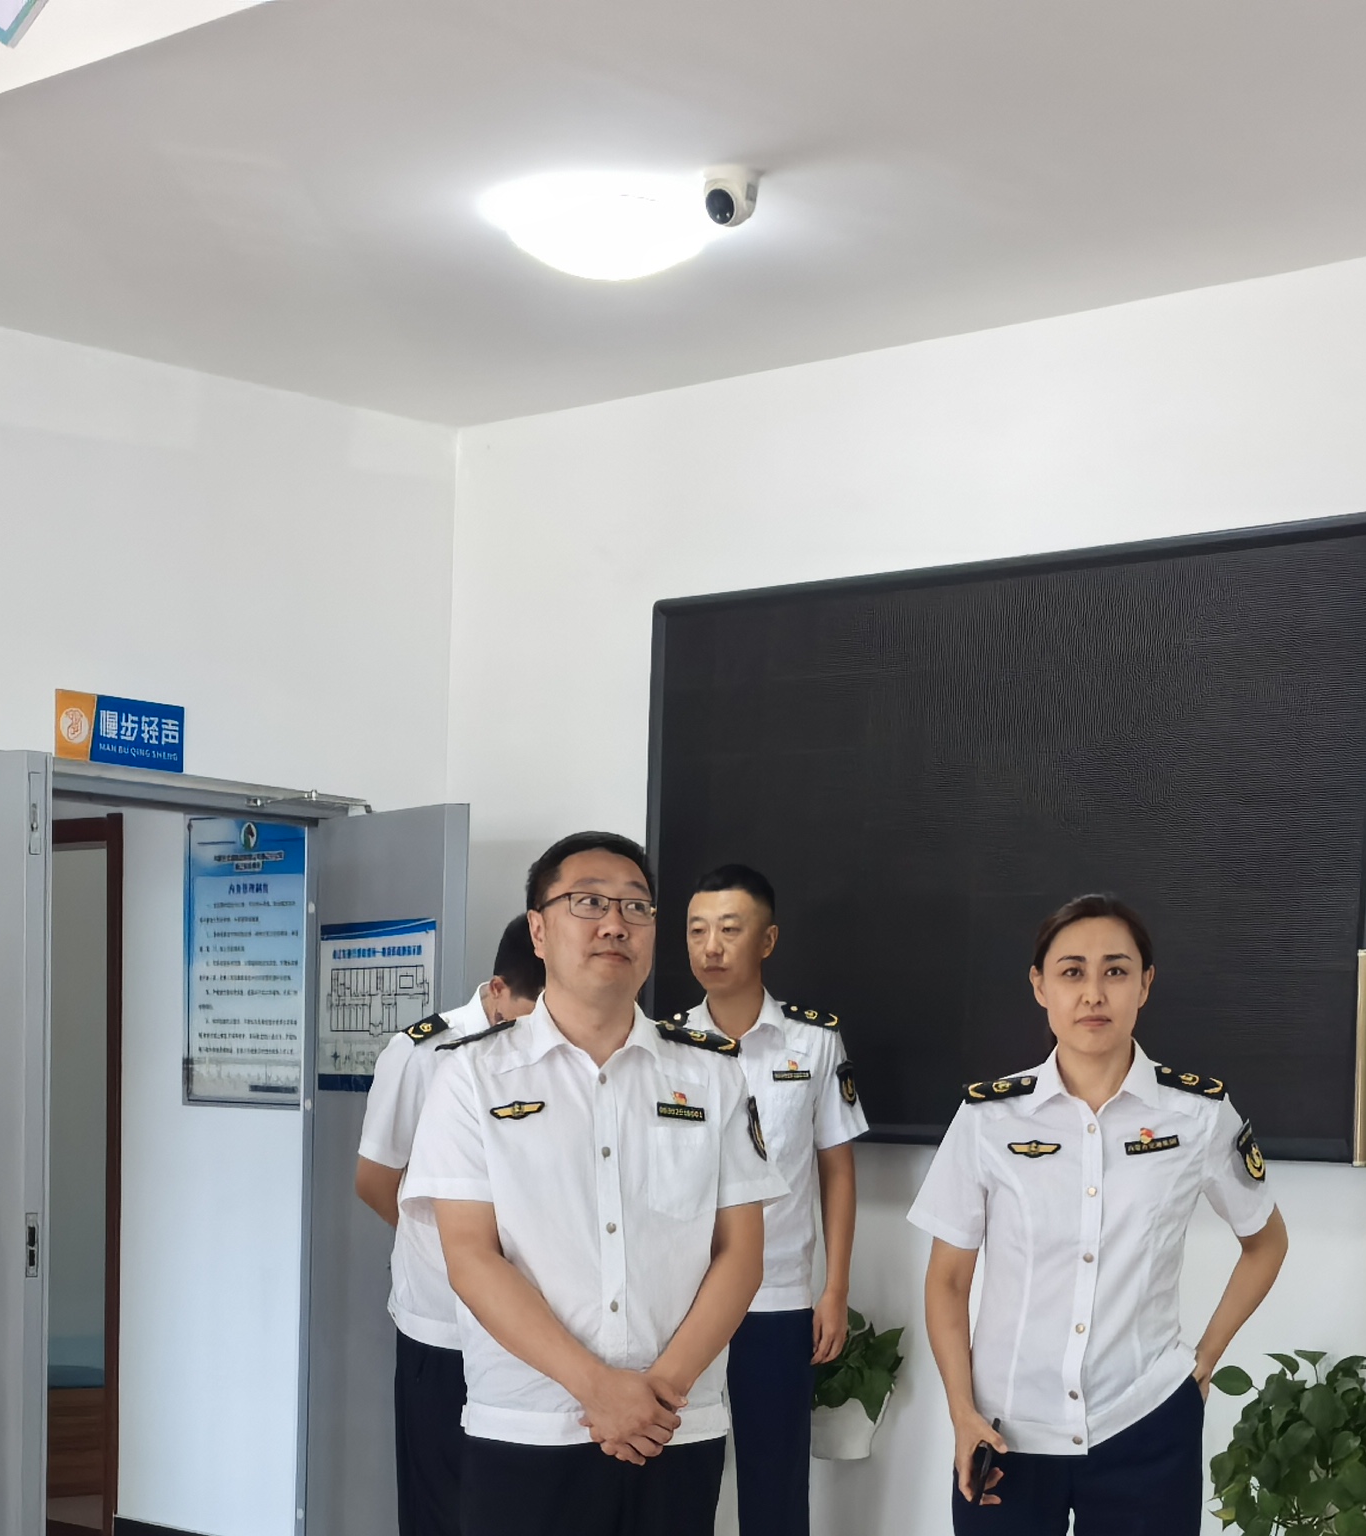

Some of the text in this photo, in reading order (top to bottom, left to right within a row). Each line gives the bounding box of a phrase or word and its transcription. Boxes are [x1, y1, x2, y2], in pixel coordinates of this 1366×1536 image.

[100, 710, 179, 745] 慢步轻声
[99, 743, 178, 761] MAN BU QING SHENG
